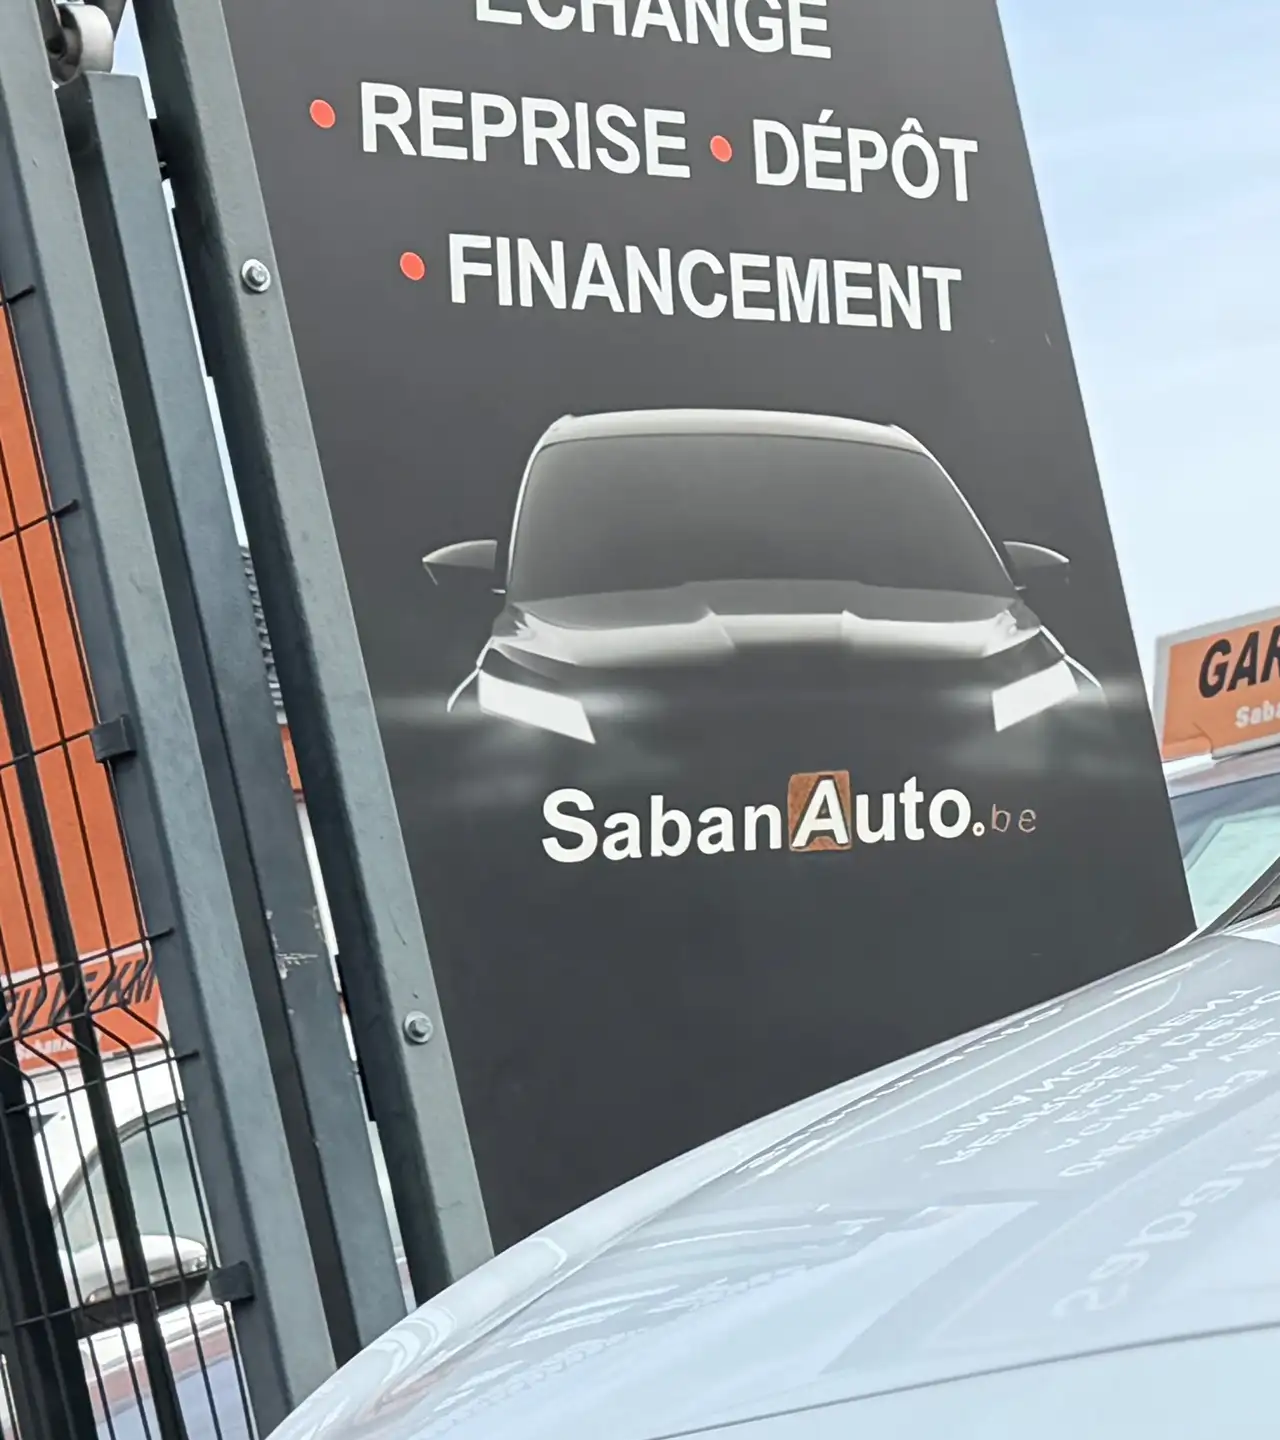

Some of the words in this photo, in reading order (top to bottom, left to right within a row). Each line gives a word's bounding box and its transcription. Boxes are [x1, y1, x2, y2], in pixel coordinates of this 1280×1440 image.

[360, 81, 692, 179] REPRISE
[752, 108, 979, 202] DÉPÔT
[449, 233, 963, 331] FINANCEMENT
